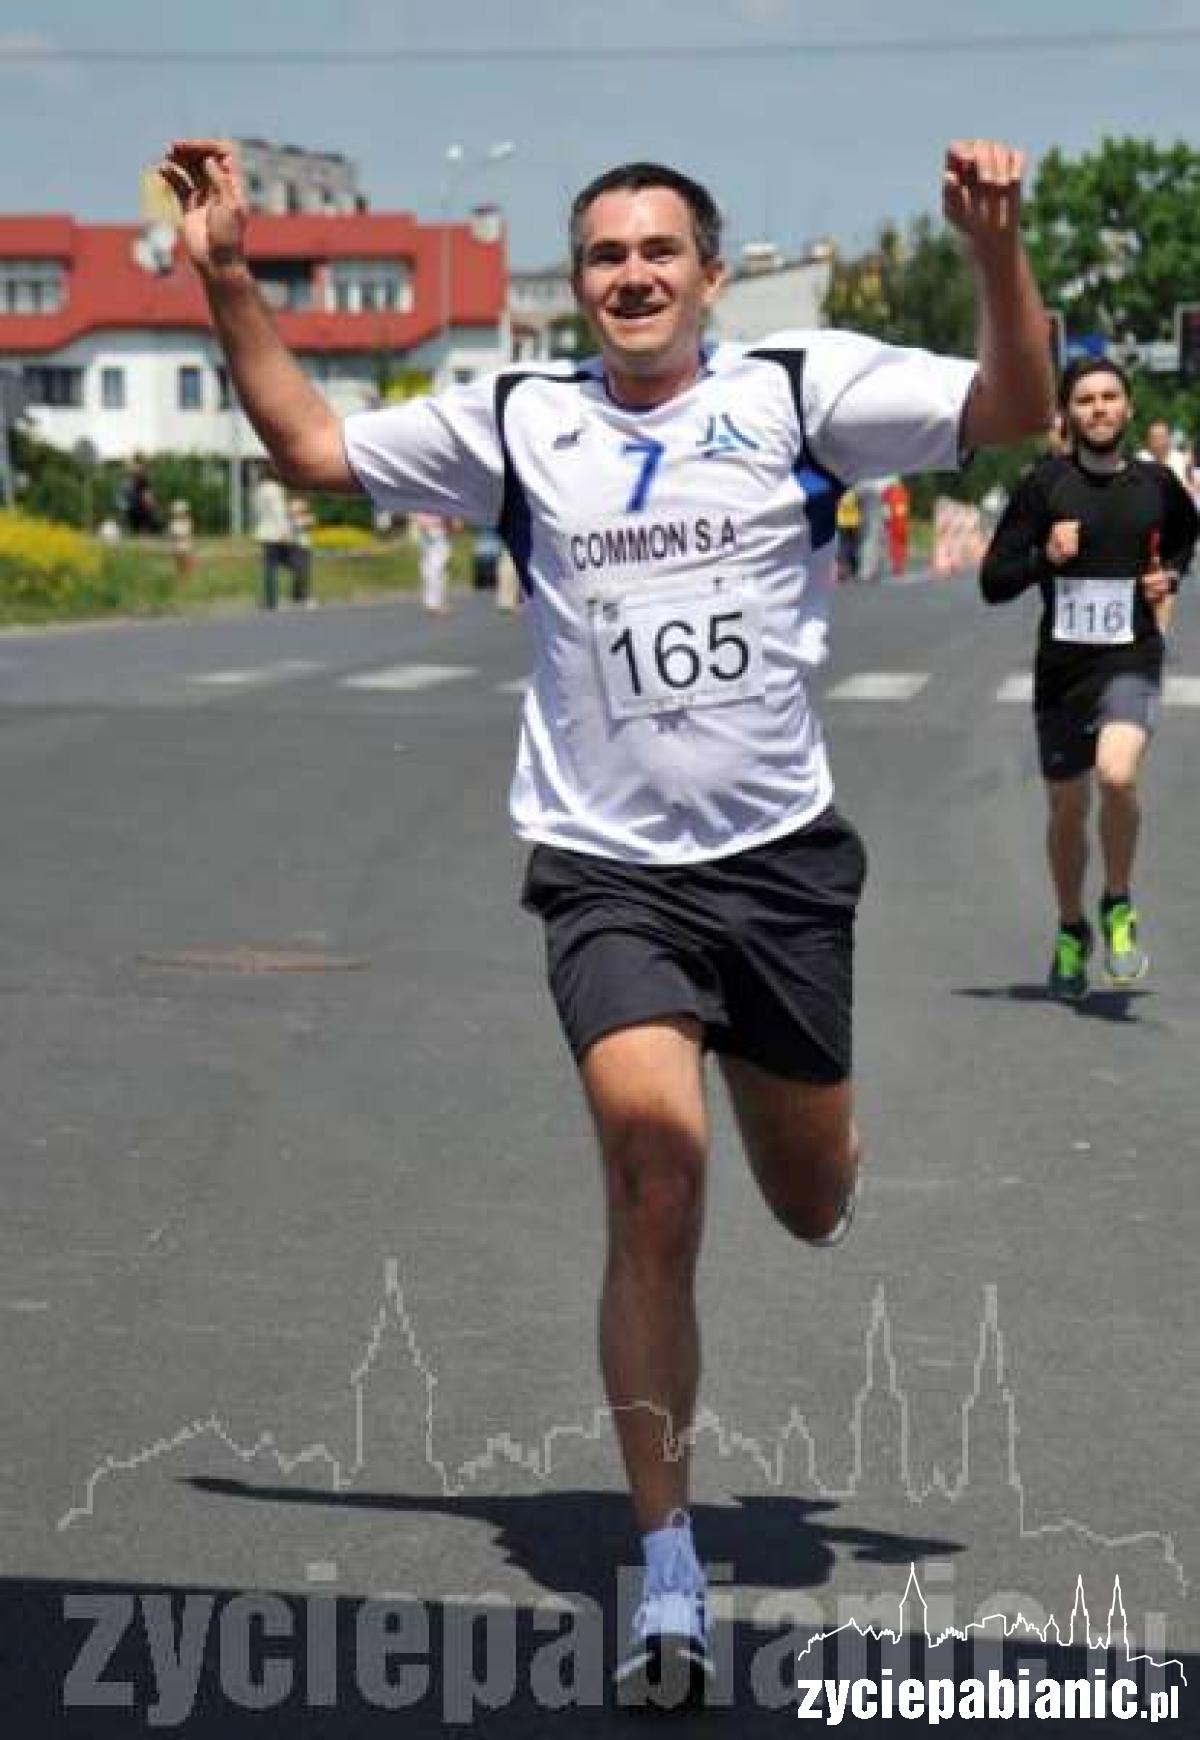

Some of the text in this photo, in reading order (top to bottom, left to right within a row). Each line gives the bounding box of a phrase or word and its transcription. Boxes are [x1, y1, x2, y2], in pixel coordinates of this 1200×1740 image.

[621, 440, 664, 512] 7
[571, 522, 687, 571] COMMON
[1063, 600, 1125, 633] 116
[609, 611, 749, 696] 165
